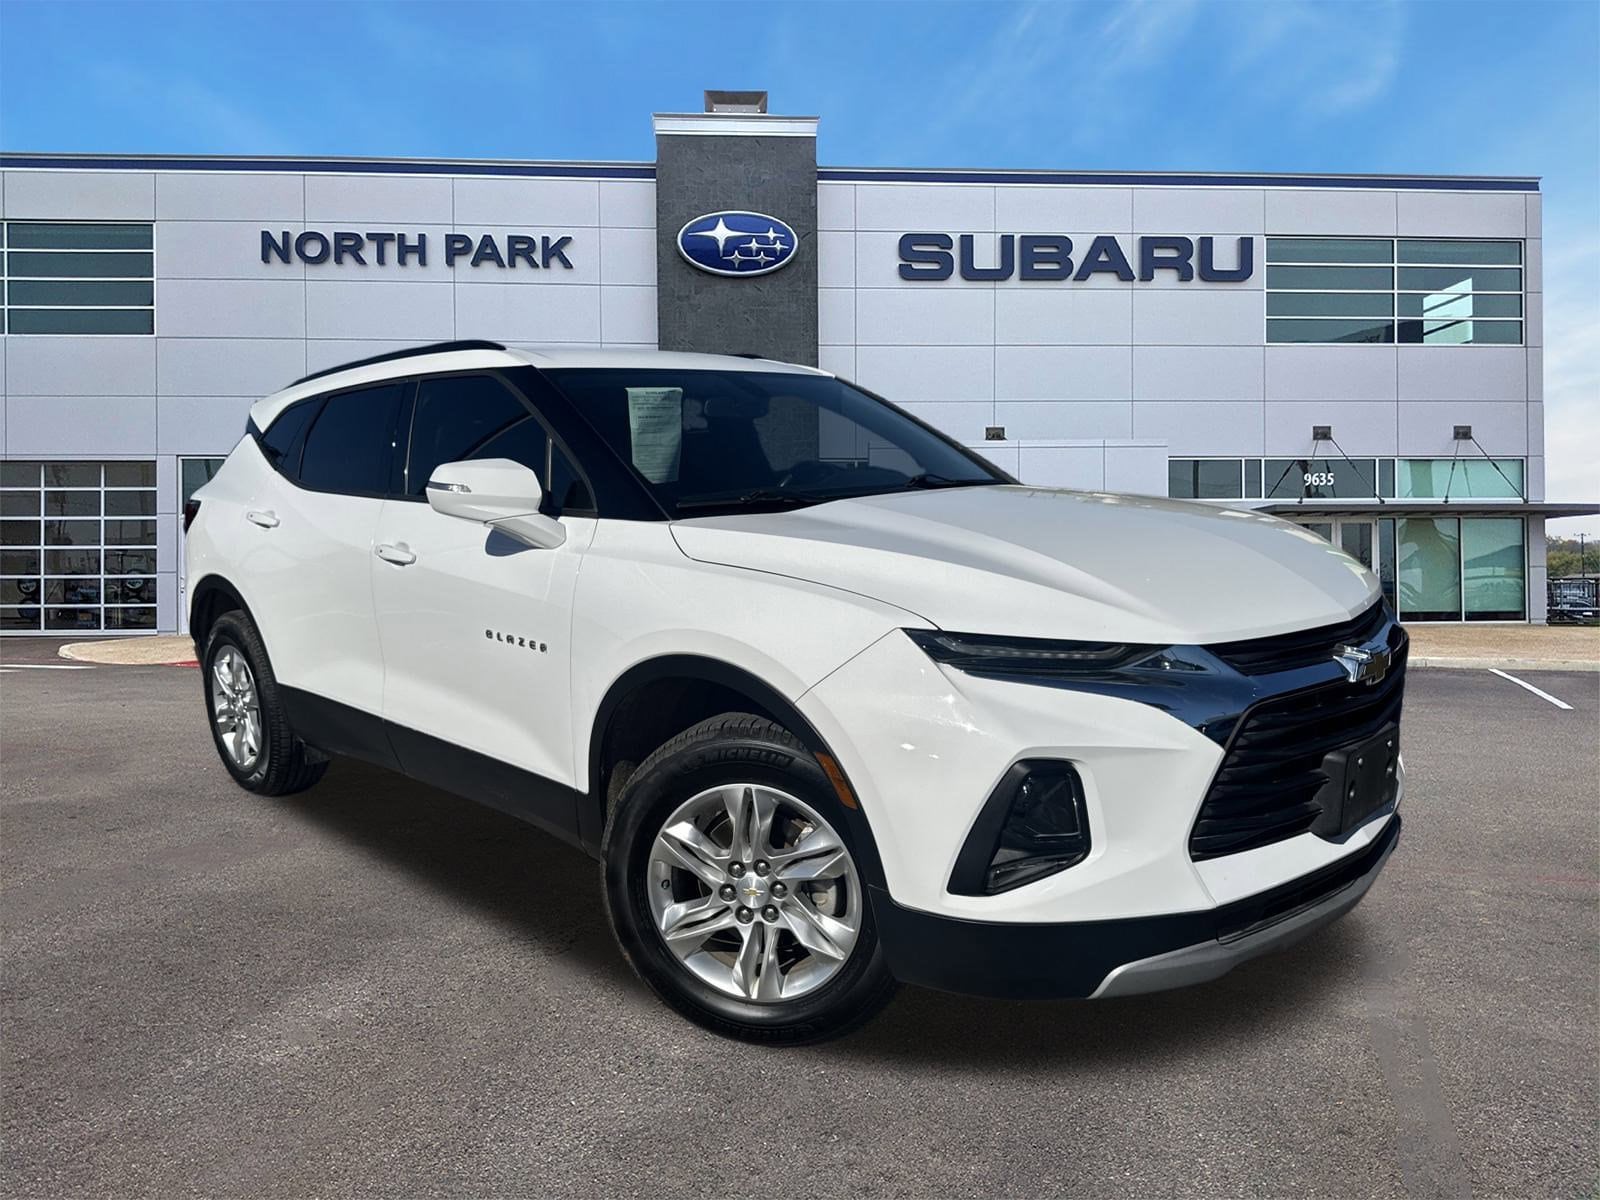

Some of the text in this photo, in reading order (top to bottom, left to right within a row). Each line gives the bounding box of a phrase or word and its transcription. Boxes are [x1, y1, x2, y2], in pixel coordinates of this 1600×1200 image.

[261, 230, 574, 269] NORTH PARK
[898, 233, 1254, 282] SUBARU
[1303, 472, 1335, 486] 9635
[485, 629, 548, 653] BLAZER
[703, 747, 793, 768] MICHELIN
